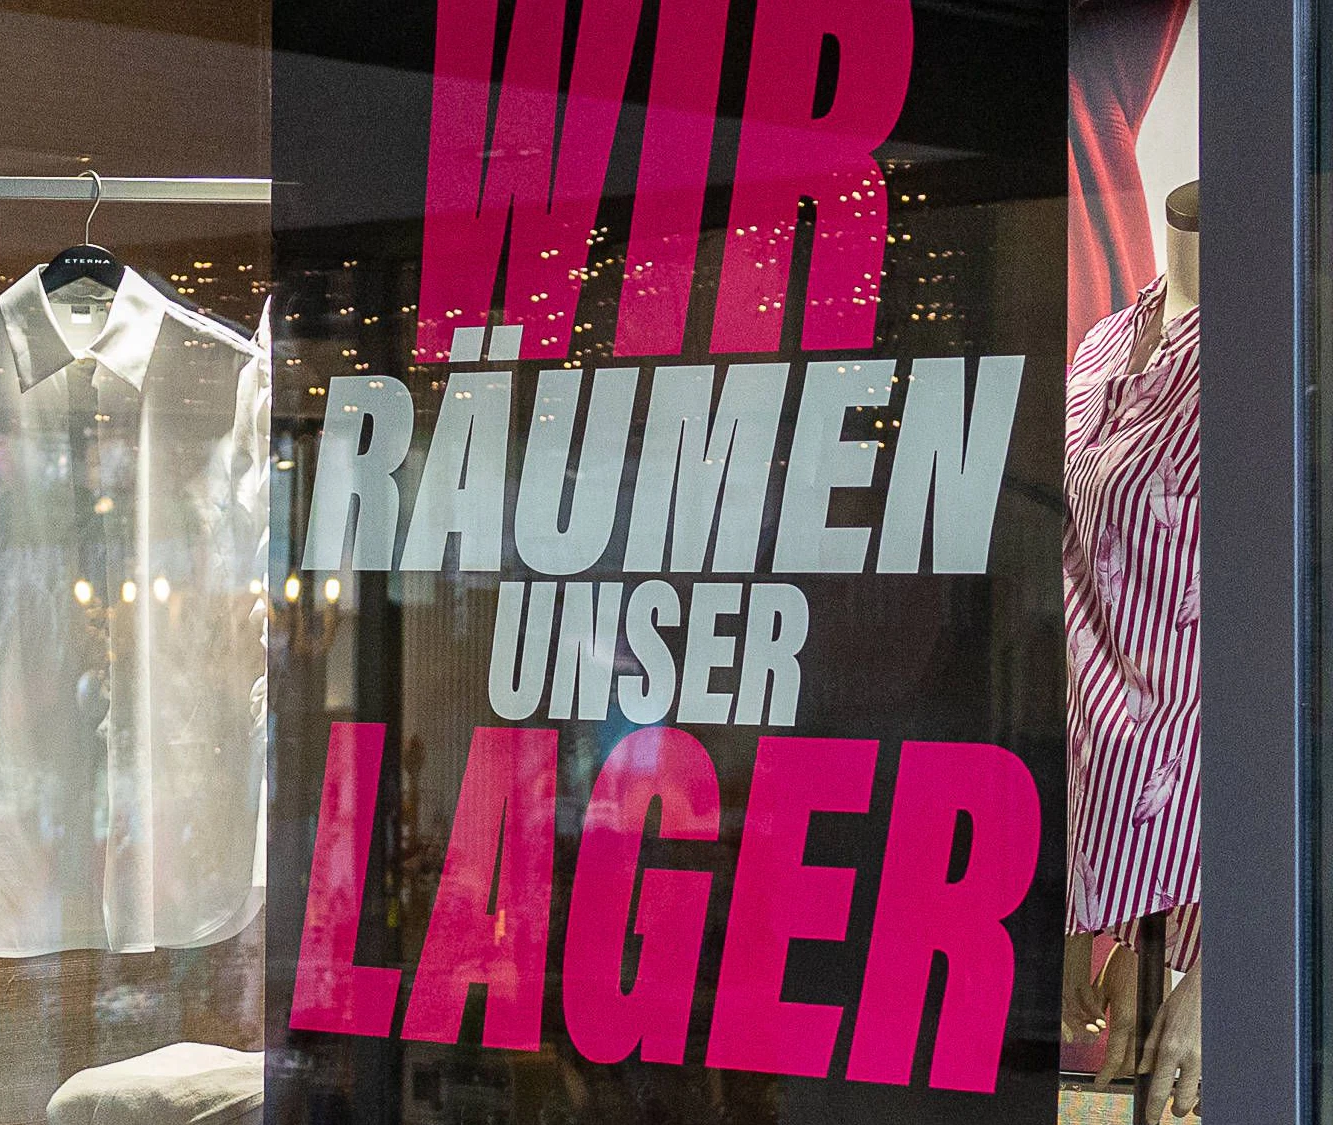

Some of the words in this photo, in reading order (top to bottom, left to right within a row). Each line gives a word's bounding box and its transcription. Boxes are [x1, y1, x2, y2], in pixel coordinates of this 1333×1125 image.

[416, 0, 914, 364] WIR
[300, 325, 1026, 575] RÄUMEN
[487, 580, 811, 727] UNSER
[289, 721, 1042, 1094] LAGER
